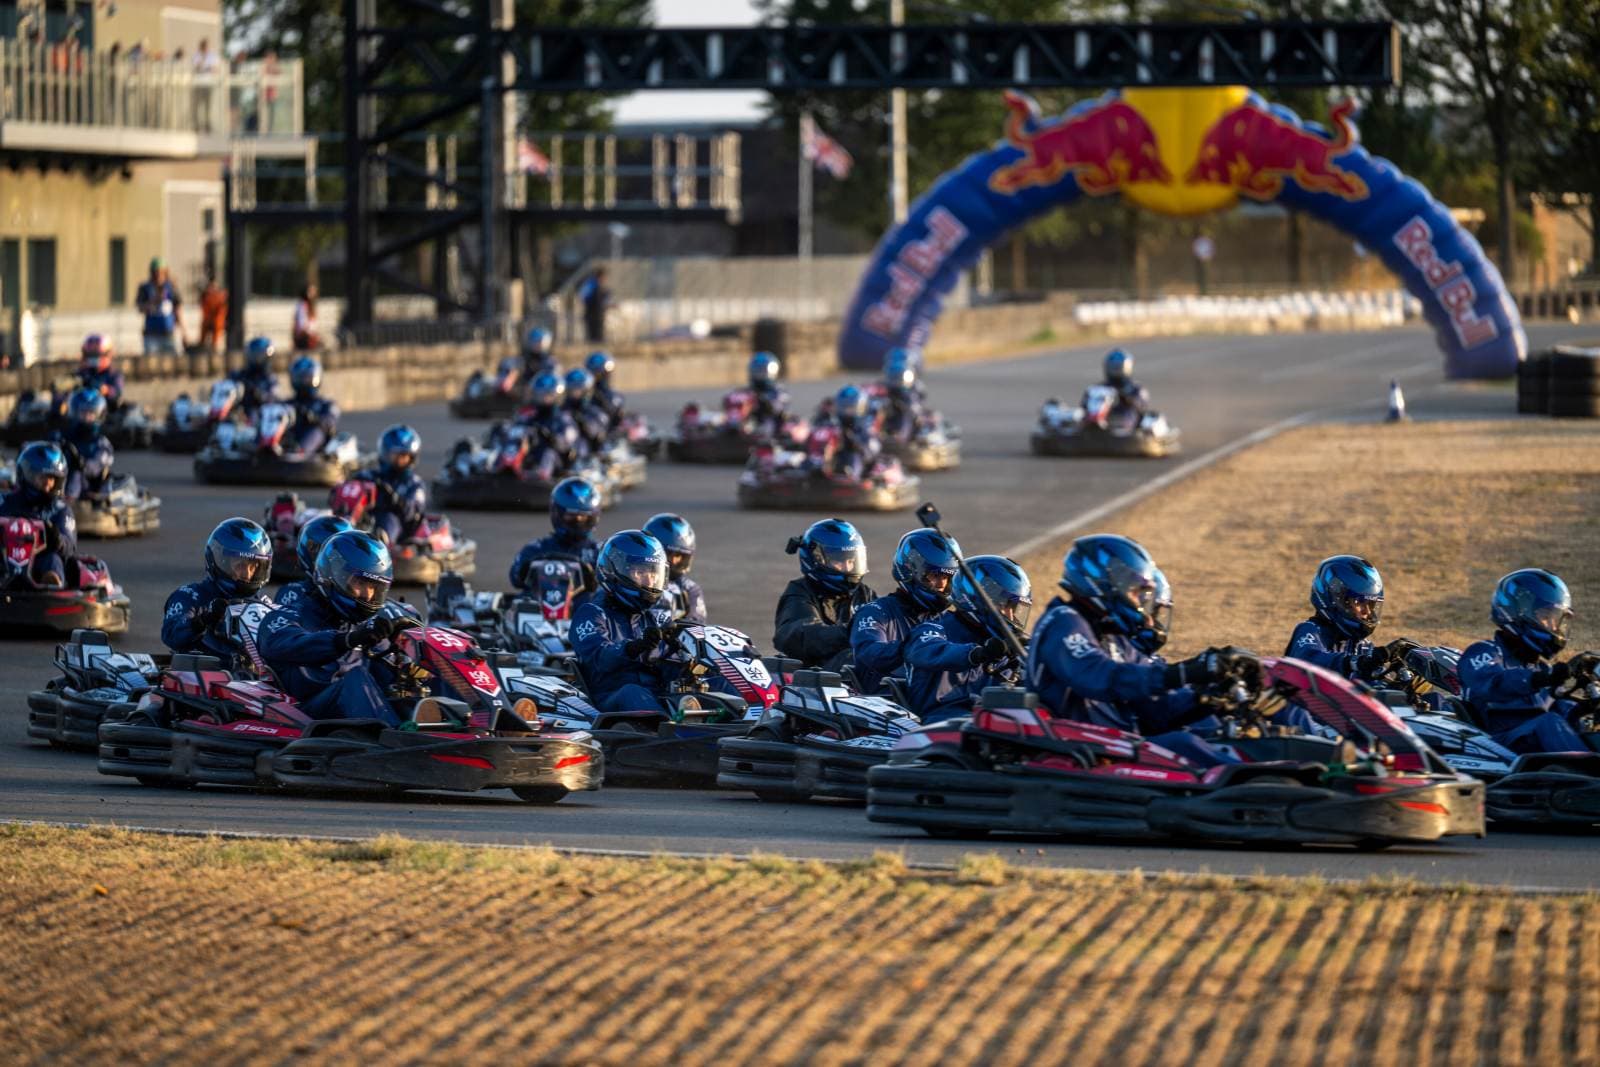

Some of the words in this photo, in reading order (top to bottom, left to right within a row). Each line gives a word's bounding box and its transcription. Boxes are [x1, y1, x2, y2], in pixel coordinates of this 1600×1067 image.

[861, 262, 926, 337] Red
[898, 206, 968, 278] Bull
[1392, 216, 1463, 290] Red
[1436, 274, 1498, 350] Bull
[543, 562, 566, 576] 03
[383, 607, 404, 620] 11
[430, 632, 464, 648] 55
[711, 633, 741, 647] 32
